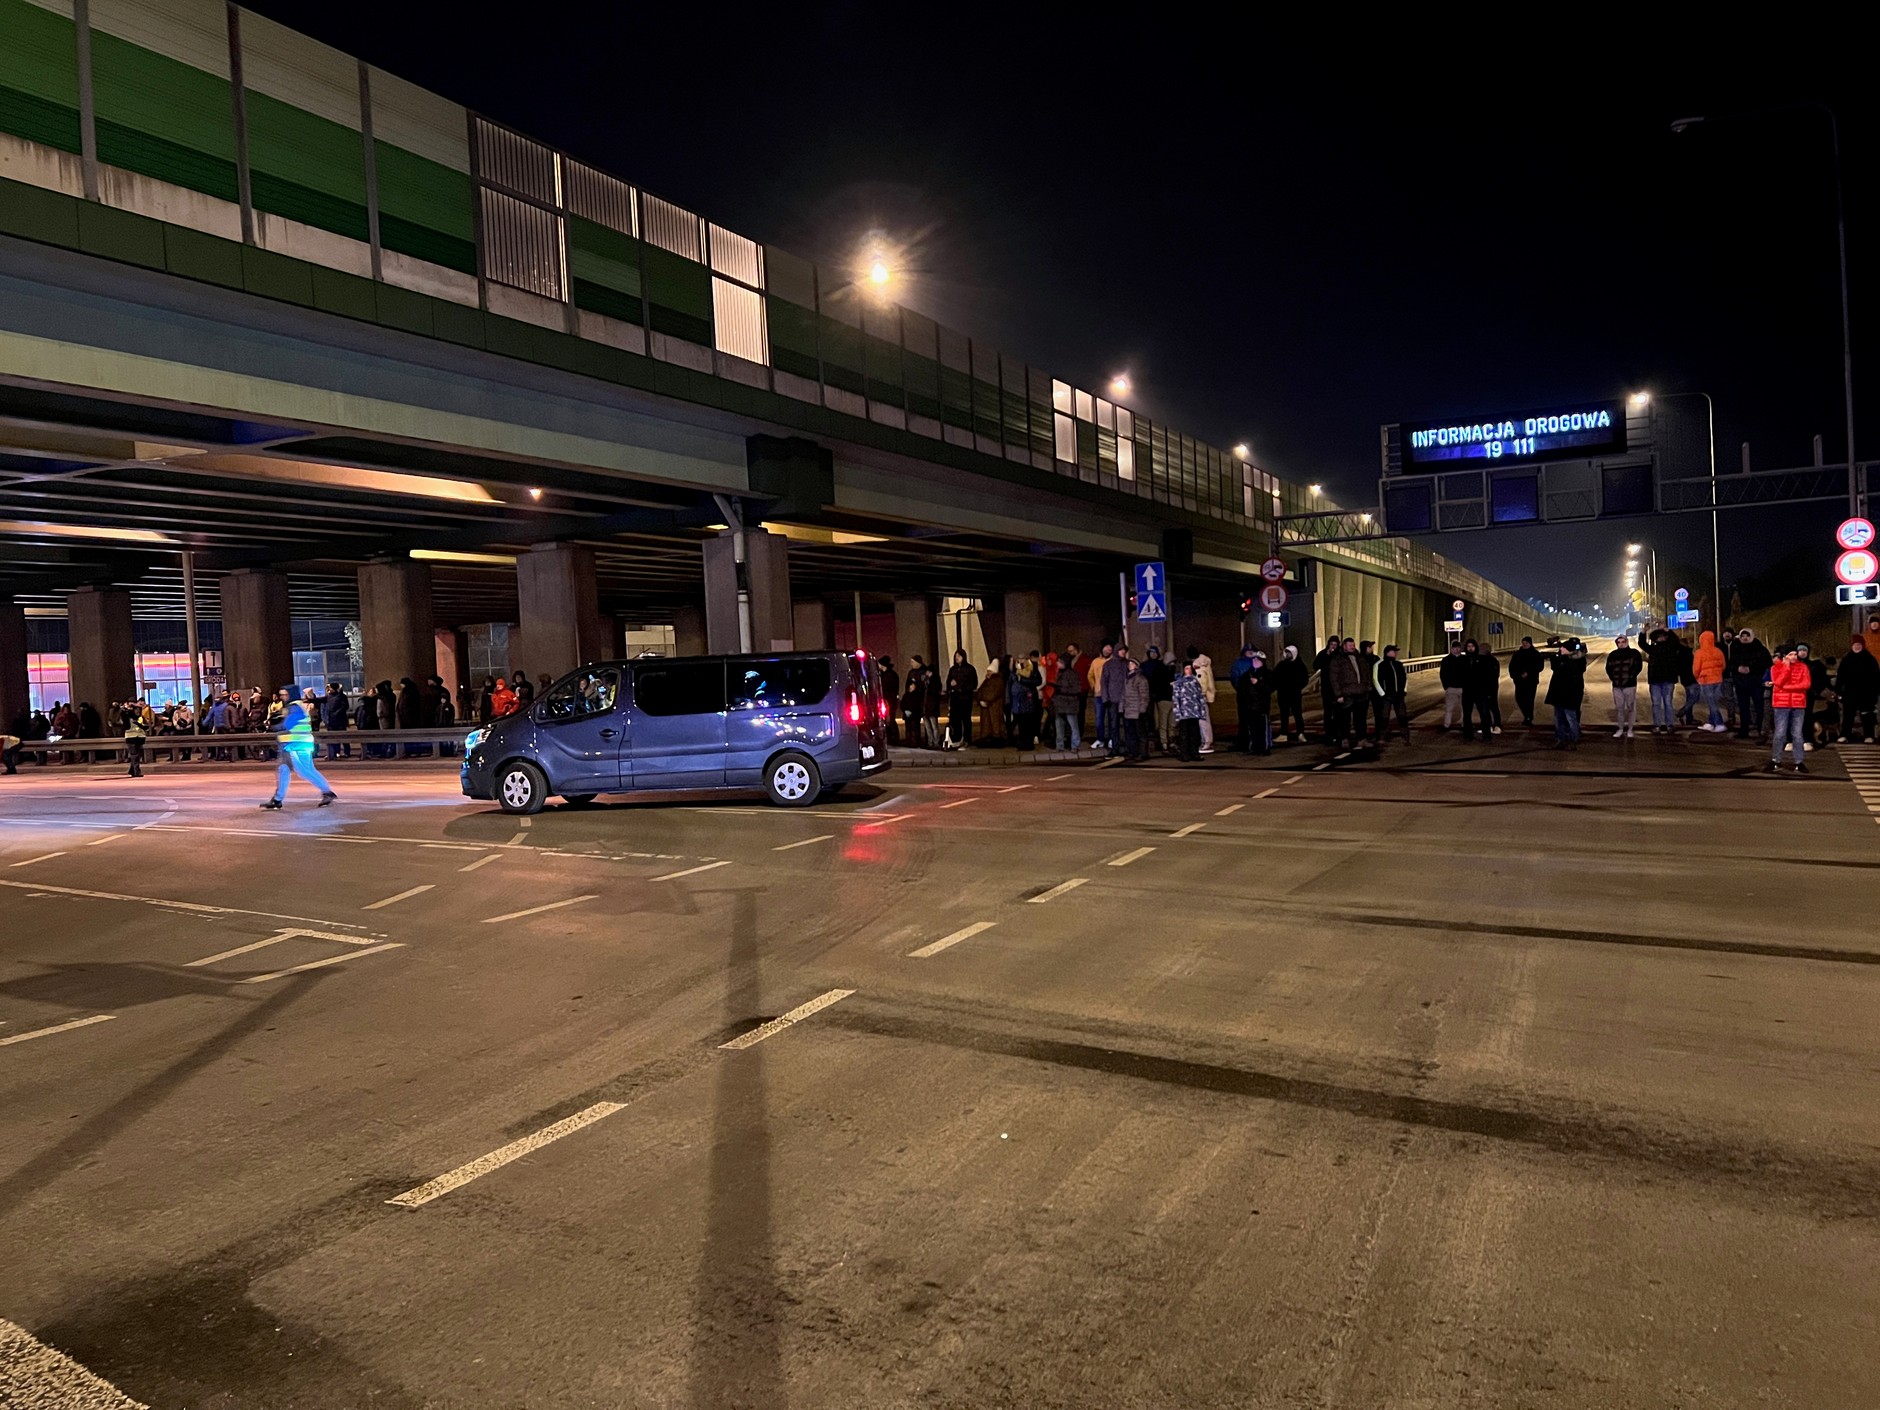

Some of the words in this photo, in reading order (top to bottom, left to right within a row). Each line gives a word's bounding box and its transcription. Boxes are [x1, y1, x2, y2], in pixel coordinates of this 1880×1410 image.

[1412, 420, 1515, 448] INFORMACJA
[1484, 441, 1503, 459] 19
[1513, 437, 1535, 455] 111
